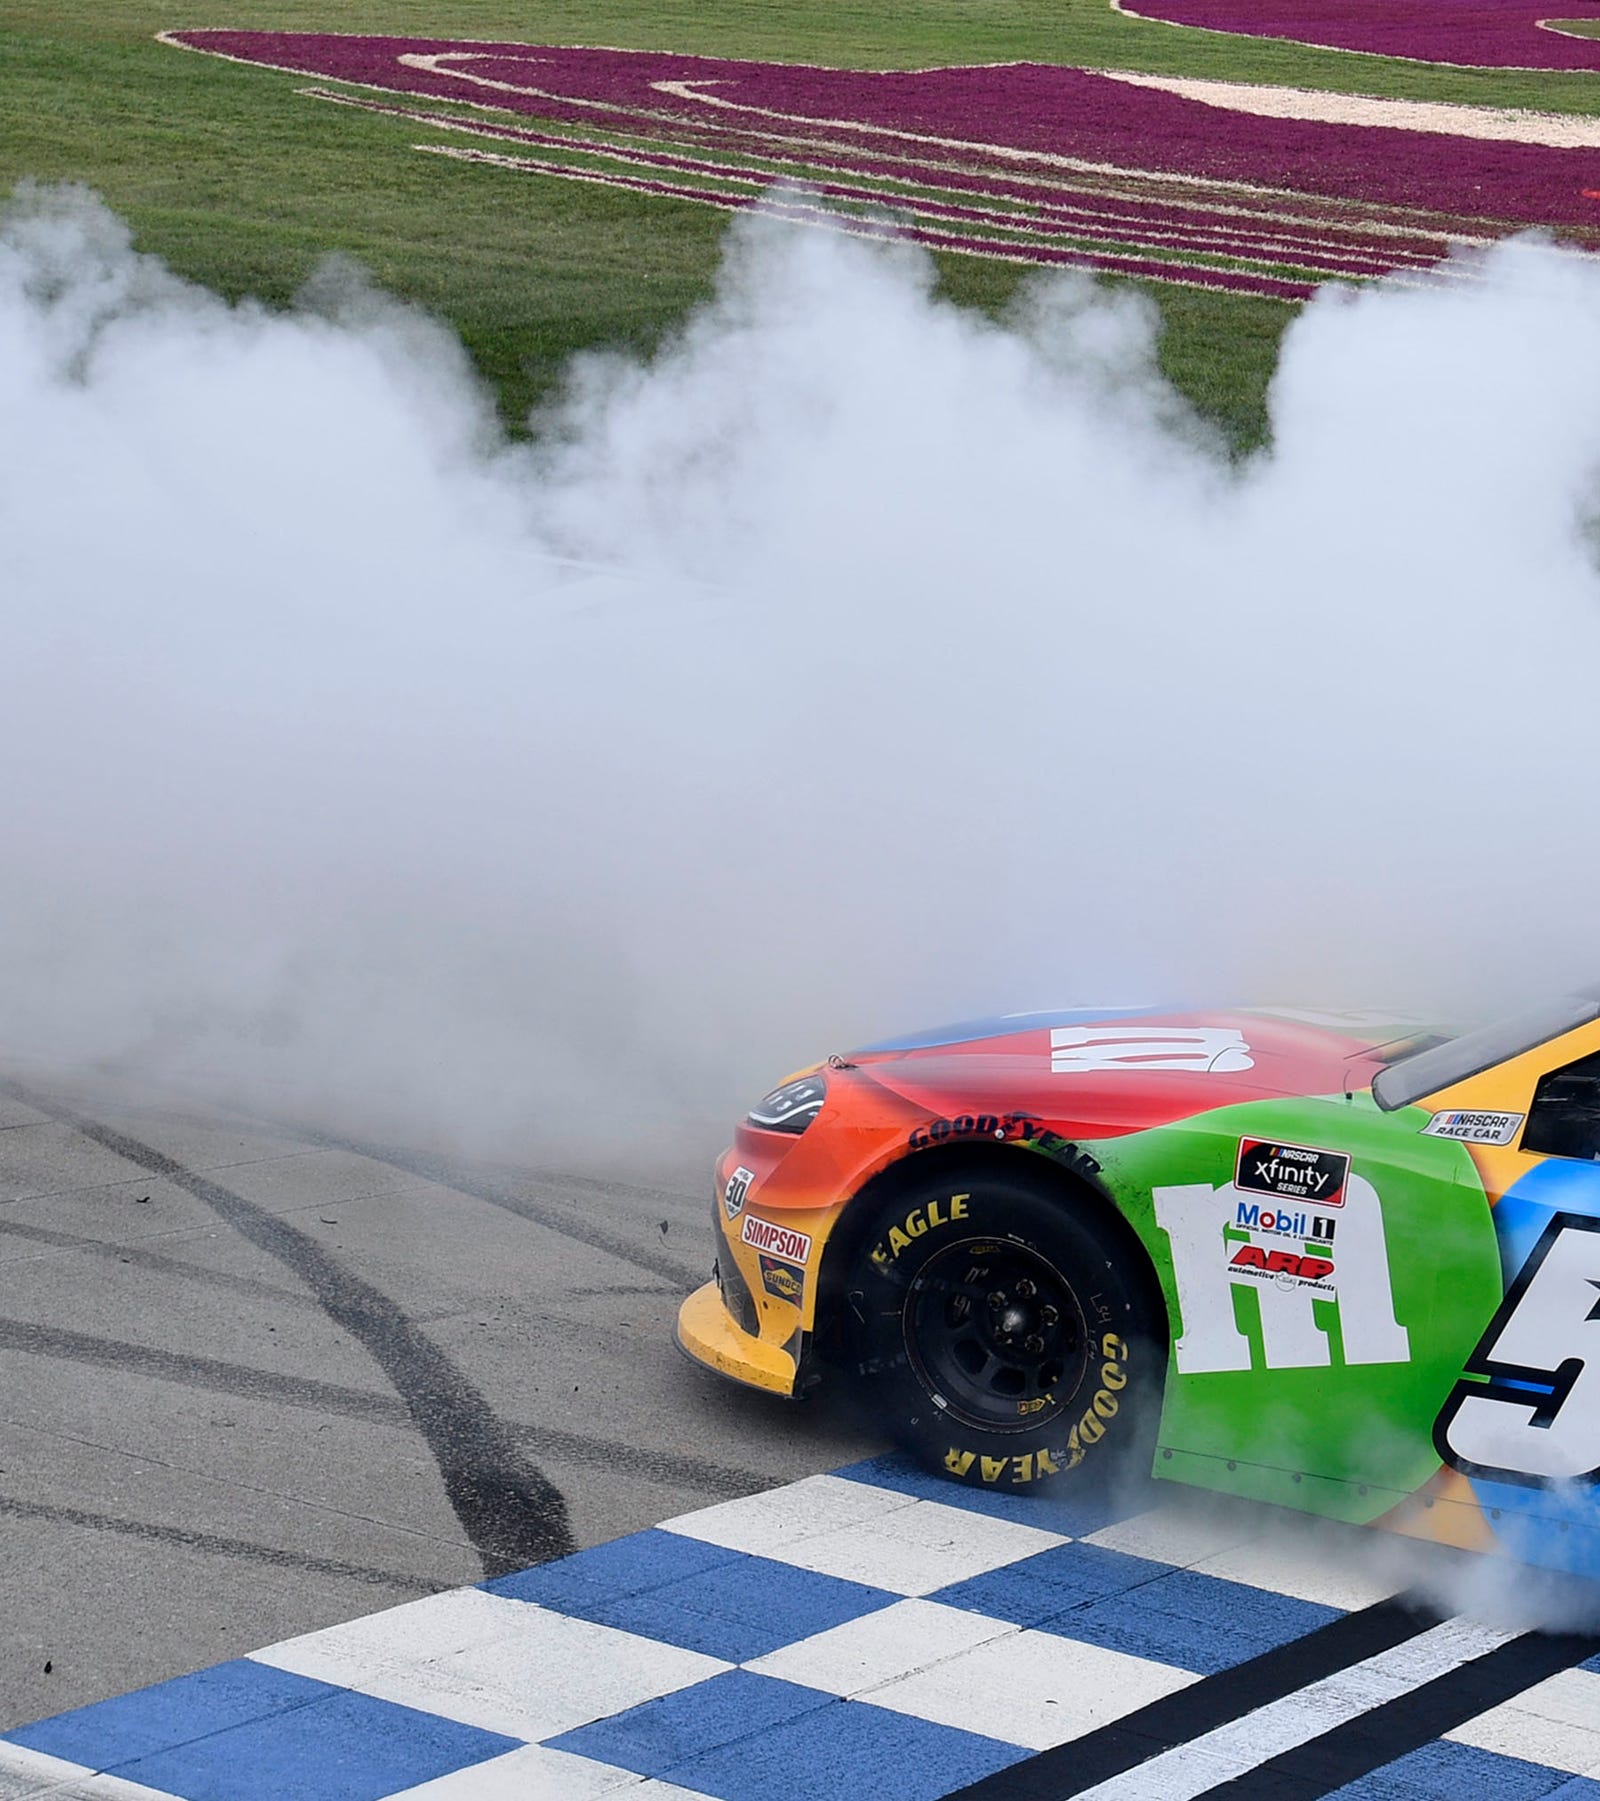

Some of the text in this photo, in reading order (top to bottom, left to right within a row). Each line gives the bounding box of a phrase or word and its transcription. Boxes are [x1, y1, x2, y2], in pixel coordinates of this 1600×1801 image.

[1435, 1127, 1501, 1140] RACE CAR
[1457, 1114, 1509, 1129] NASCAR
[909, 1112, 1104, 1176] GOODYEAR
[1280, 1148, 1319, 1164] NASCAR
[726, 1177, 747, 1207] 30
[1255, 1159, 1330, 1193] xfinity
[1276, 1182, 1308, 1196] SERIES
[871, 1193, 970, 1264] EAGLE
[1236, 1202, 1306, 1235] Mobil
[744, 1218, 808, 1260] SIMPSON
[1227, 1265, 1336, 1293] automotive products
[1230, 1245, 1334, 1280] ARP
[944, 1333, 1128, 1484] GOODYEAR
